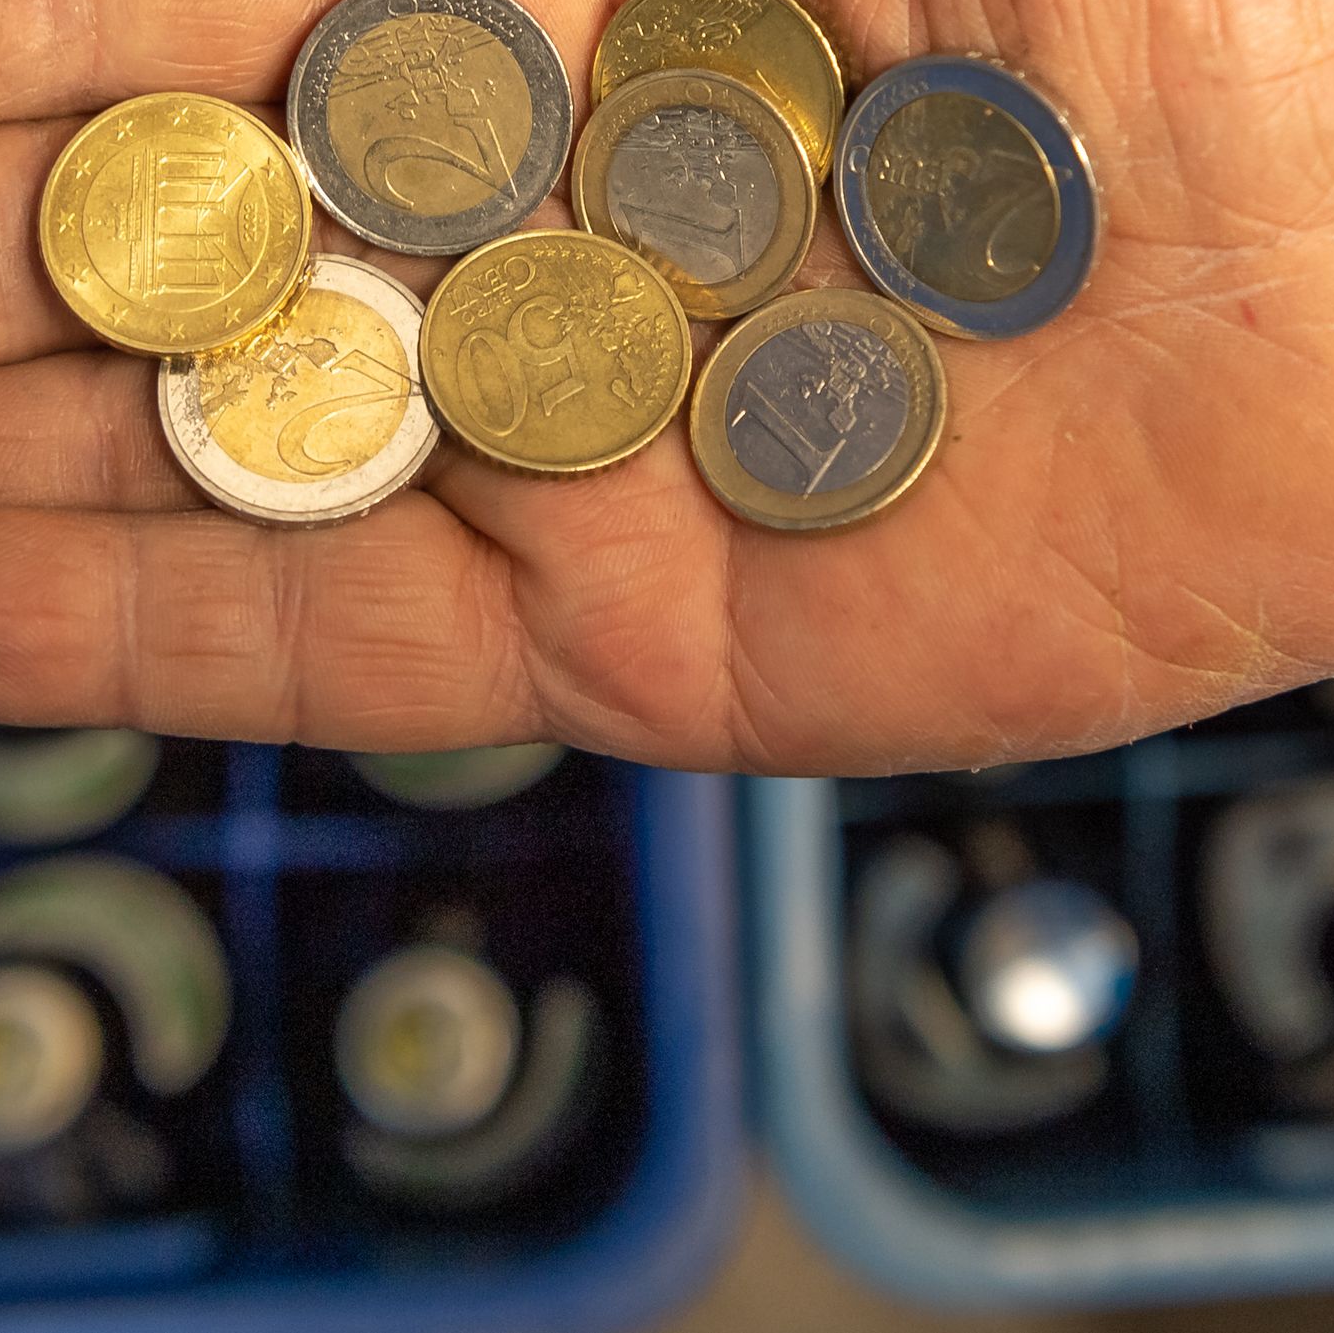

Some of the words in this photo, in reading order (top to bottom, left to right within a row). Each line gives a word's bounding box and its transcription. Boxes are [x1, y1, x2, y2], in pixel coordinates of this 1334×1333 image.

[363, 118, 518, 211] 2
[447, 254, 537, 316] CENT
[618, 201, 746, 280] 1
[461, 290, 513, 325] EURO
[277, 348, 424, 476] 2
[456, 294, 586, 437] 50
[731, 380, 847, 500] 1
